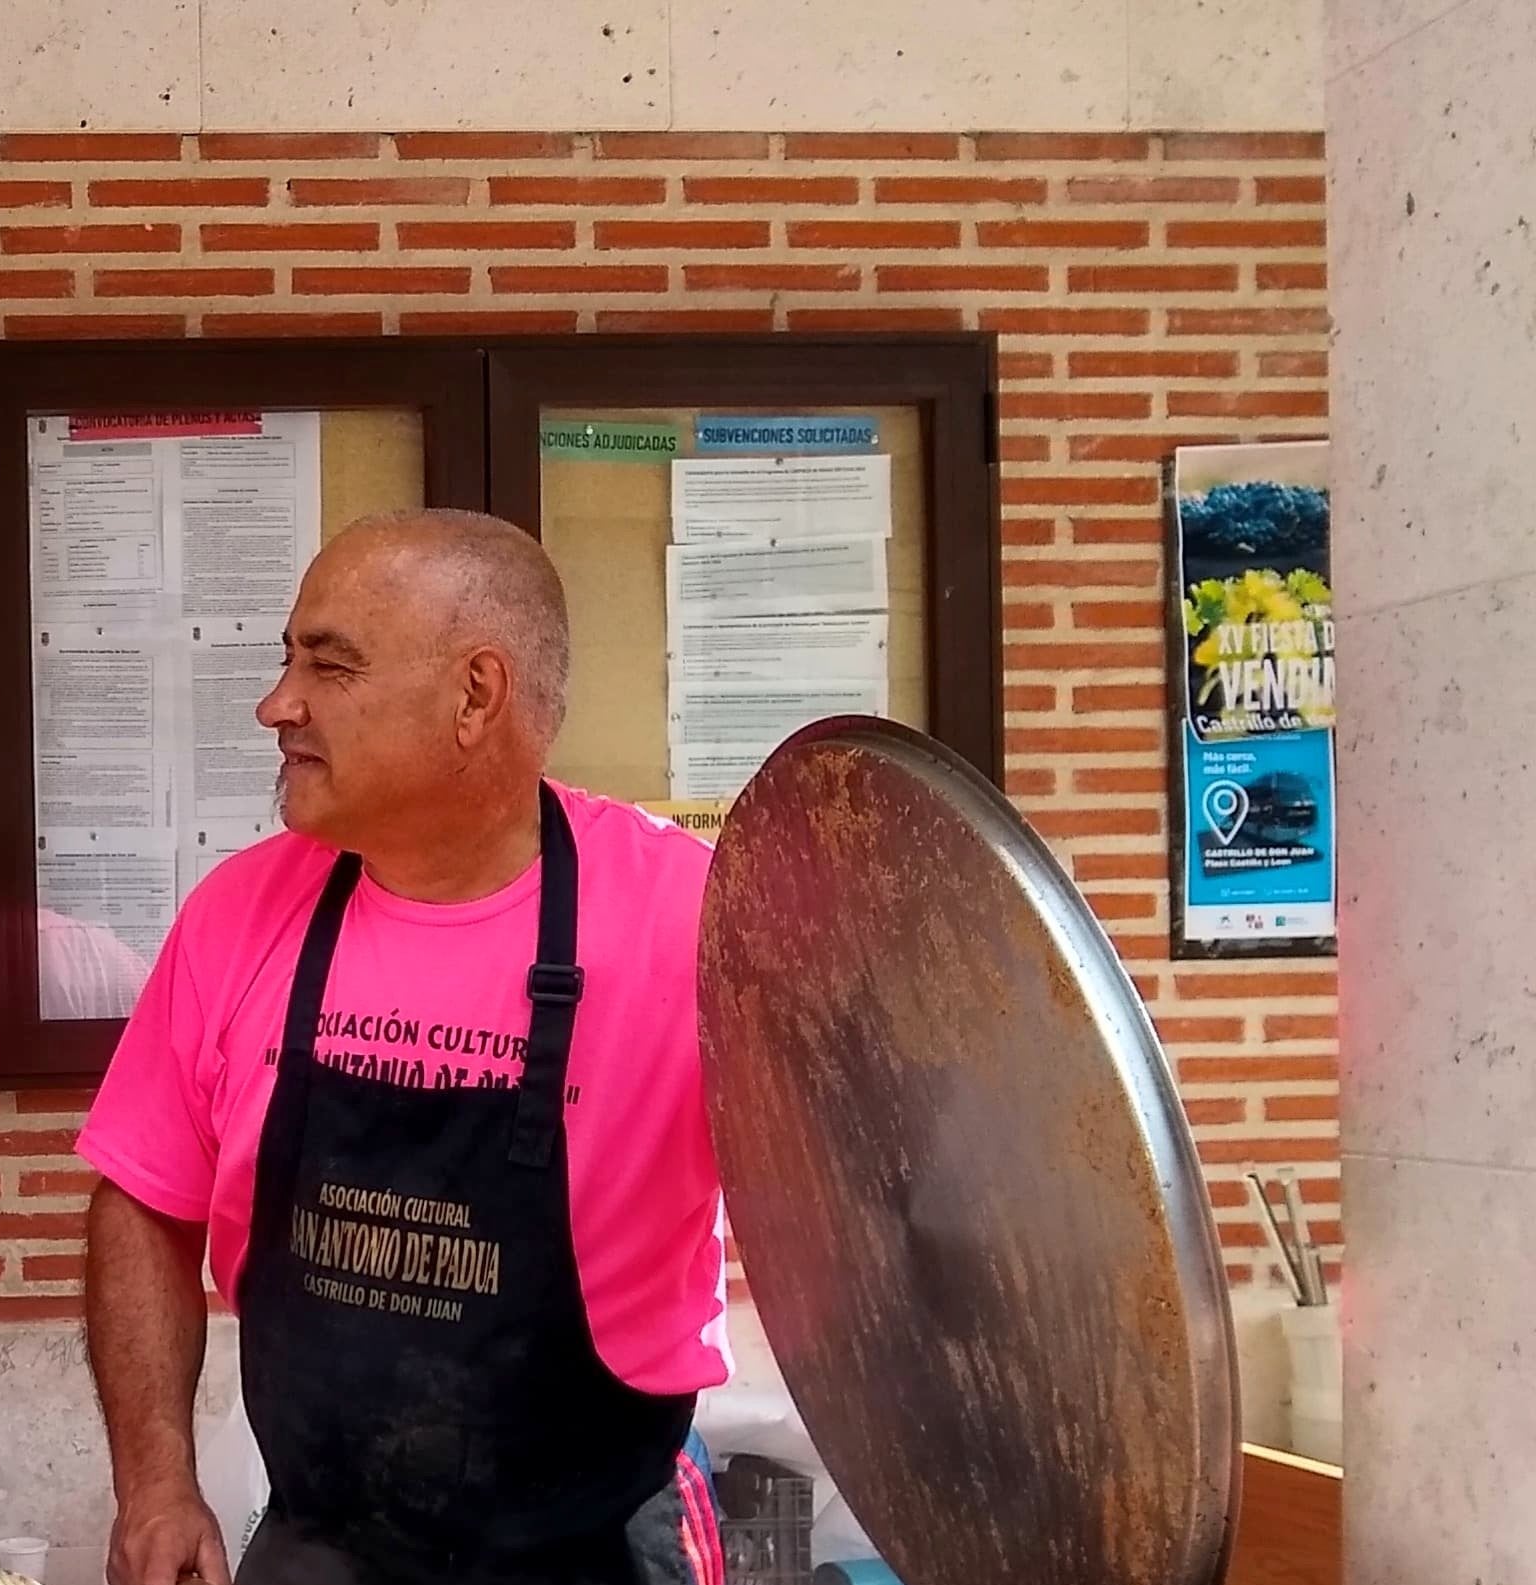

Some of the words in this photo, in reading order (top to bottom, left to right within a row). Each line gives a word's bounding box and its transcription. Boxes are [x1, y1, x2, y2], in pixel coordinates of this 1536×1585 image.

[593, 434, 677, 452] ADJUDICADAS
[703, 426, 794, 444] SUBVENCIONES
[796, 426, 873, 444] SOLICITADAS
[1218, 622, 1244, 655] XV
[1250, 619, 1318, 654] FIESTA
[1196, 712, 1276, 734] Castrillo
[1278, 711, 1302, 731] de
[1205, 848, 1253, 858] CASTRILLO
[1254, 848, 1267, 857] DE
[1268, 847, 1289, 857] DON
[1290, 847, 1315, 857] JUAN
[319, 1183, 402, 1219] ASOCIACIÓN
[404, 1197, 471, 1228] CULTURAL
[290, 1205, 319, 1265] SAN
[316, 1217, 401, 1281] ANTONIO
[402, 1231, 435, 1285] DE
[434, 1236, 500, 1296] PADUA
[304, 1273, 365, 1307] CASTRILLO
[368, 1290, 388, 1310] DE
[390, 1293, 423, 1317] DON
[424, 1299, 463, 1323] JUAN
